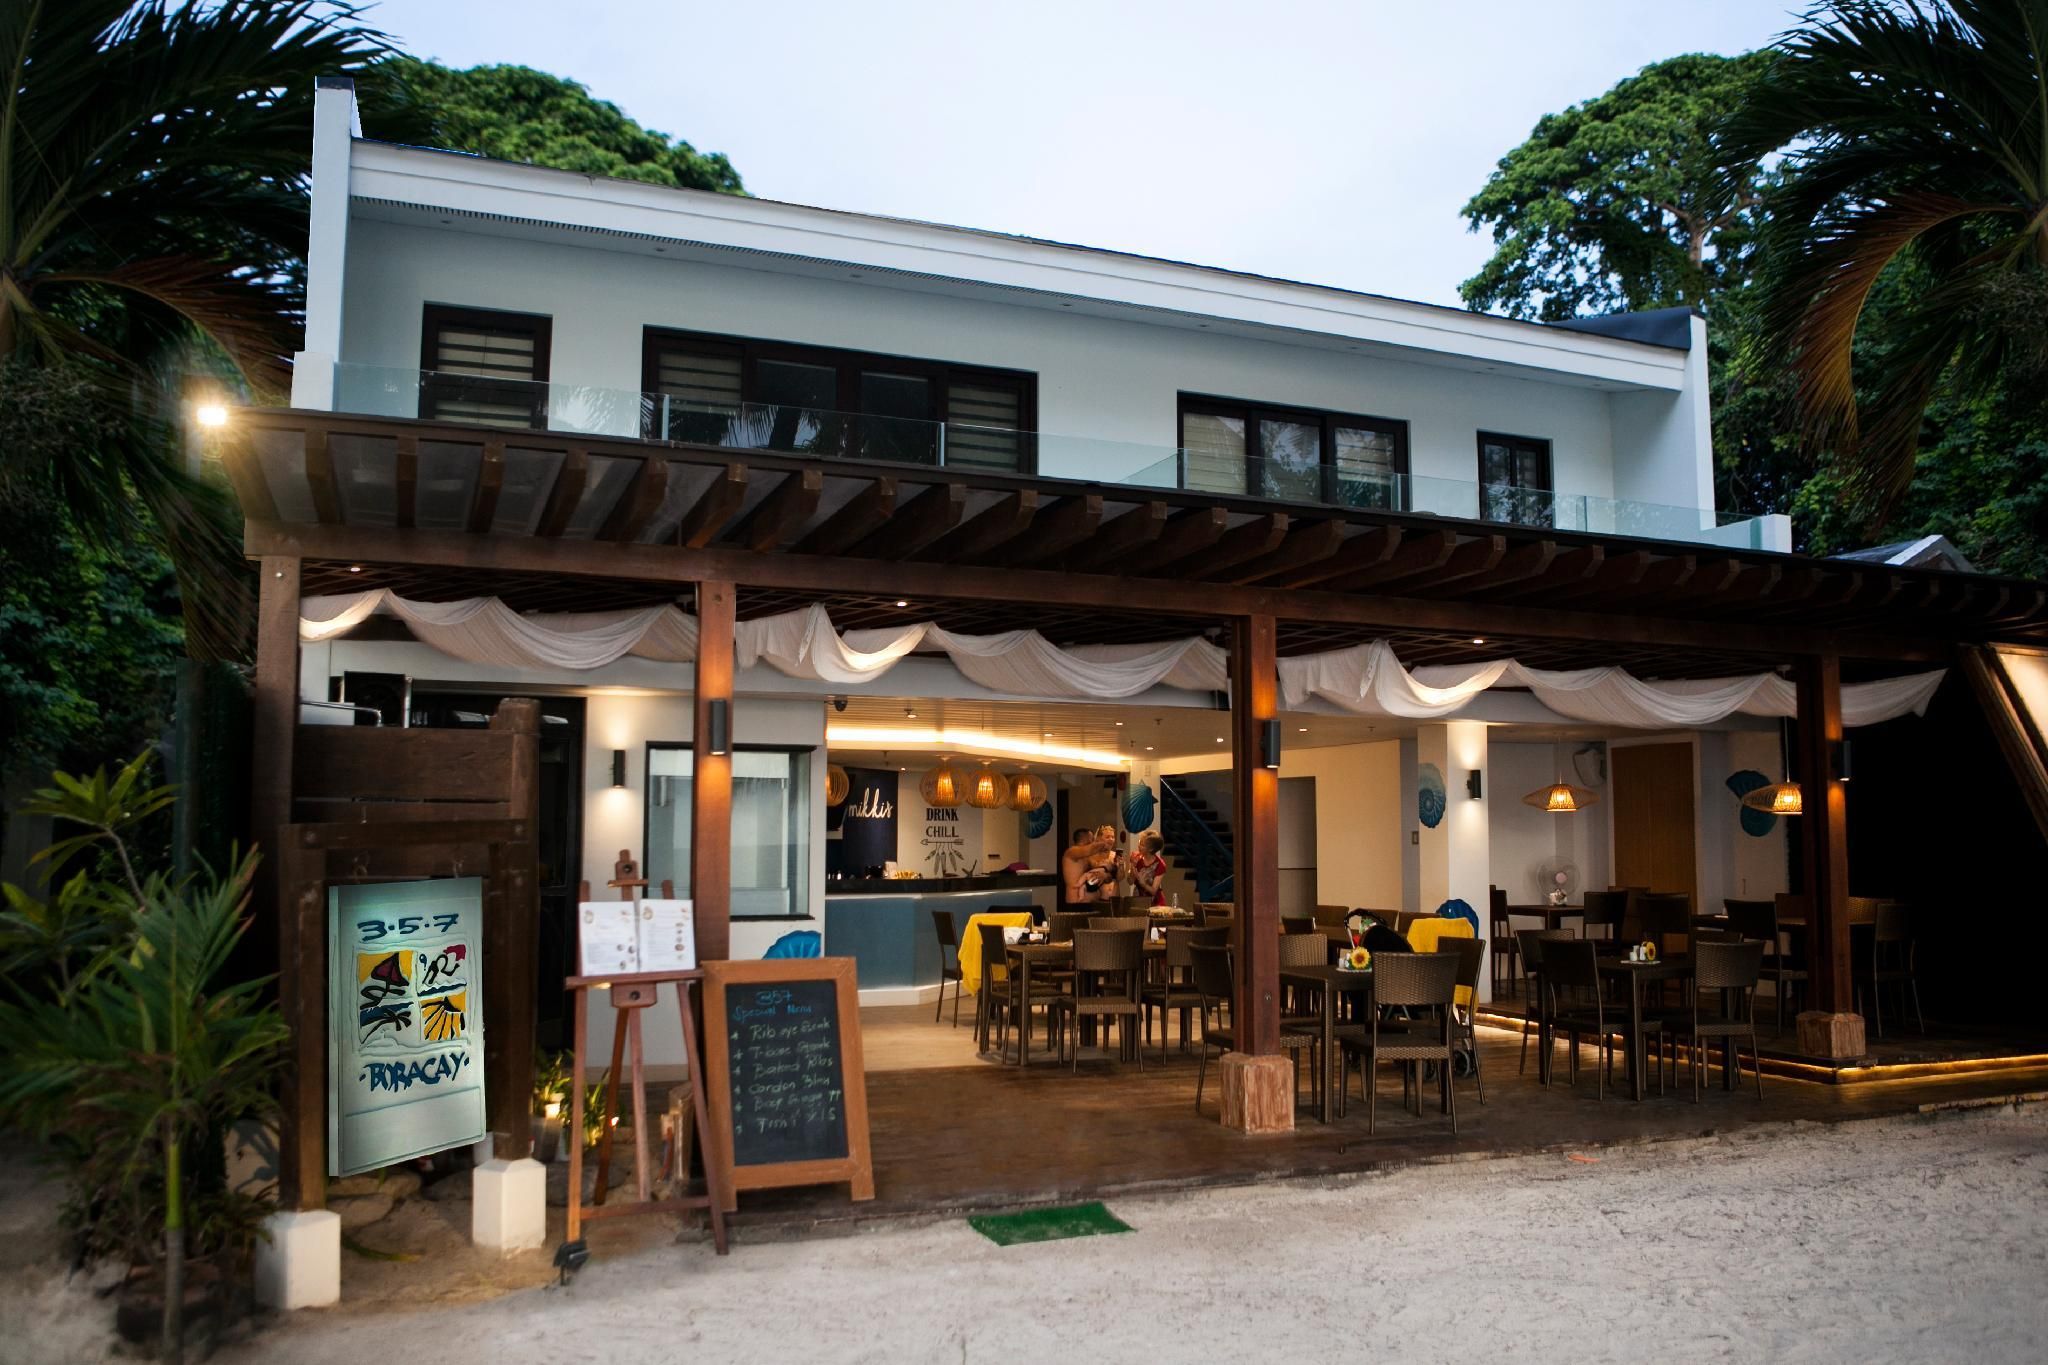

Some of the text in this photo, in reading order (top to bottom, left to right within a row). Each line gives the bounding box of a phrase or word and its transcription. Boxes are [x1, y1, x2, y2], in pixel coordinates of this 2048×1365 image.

[926, 807, 959, 821] DRINK
[926, 825, 960, 838] CHILL
[756, 989, 793, 1005] 357
[362, 1052, 467, 1092] BORACAY
